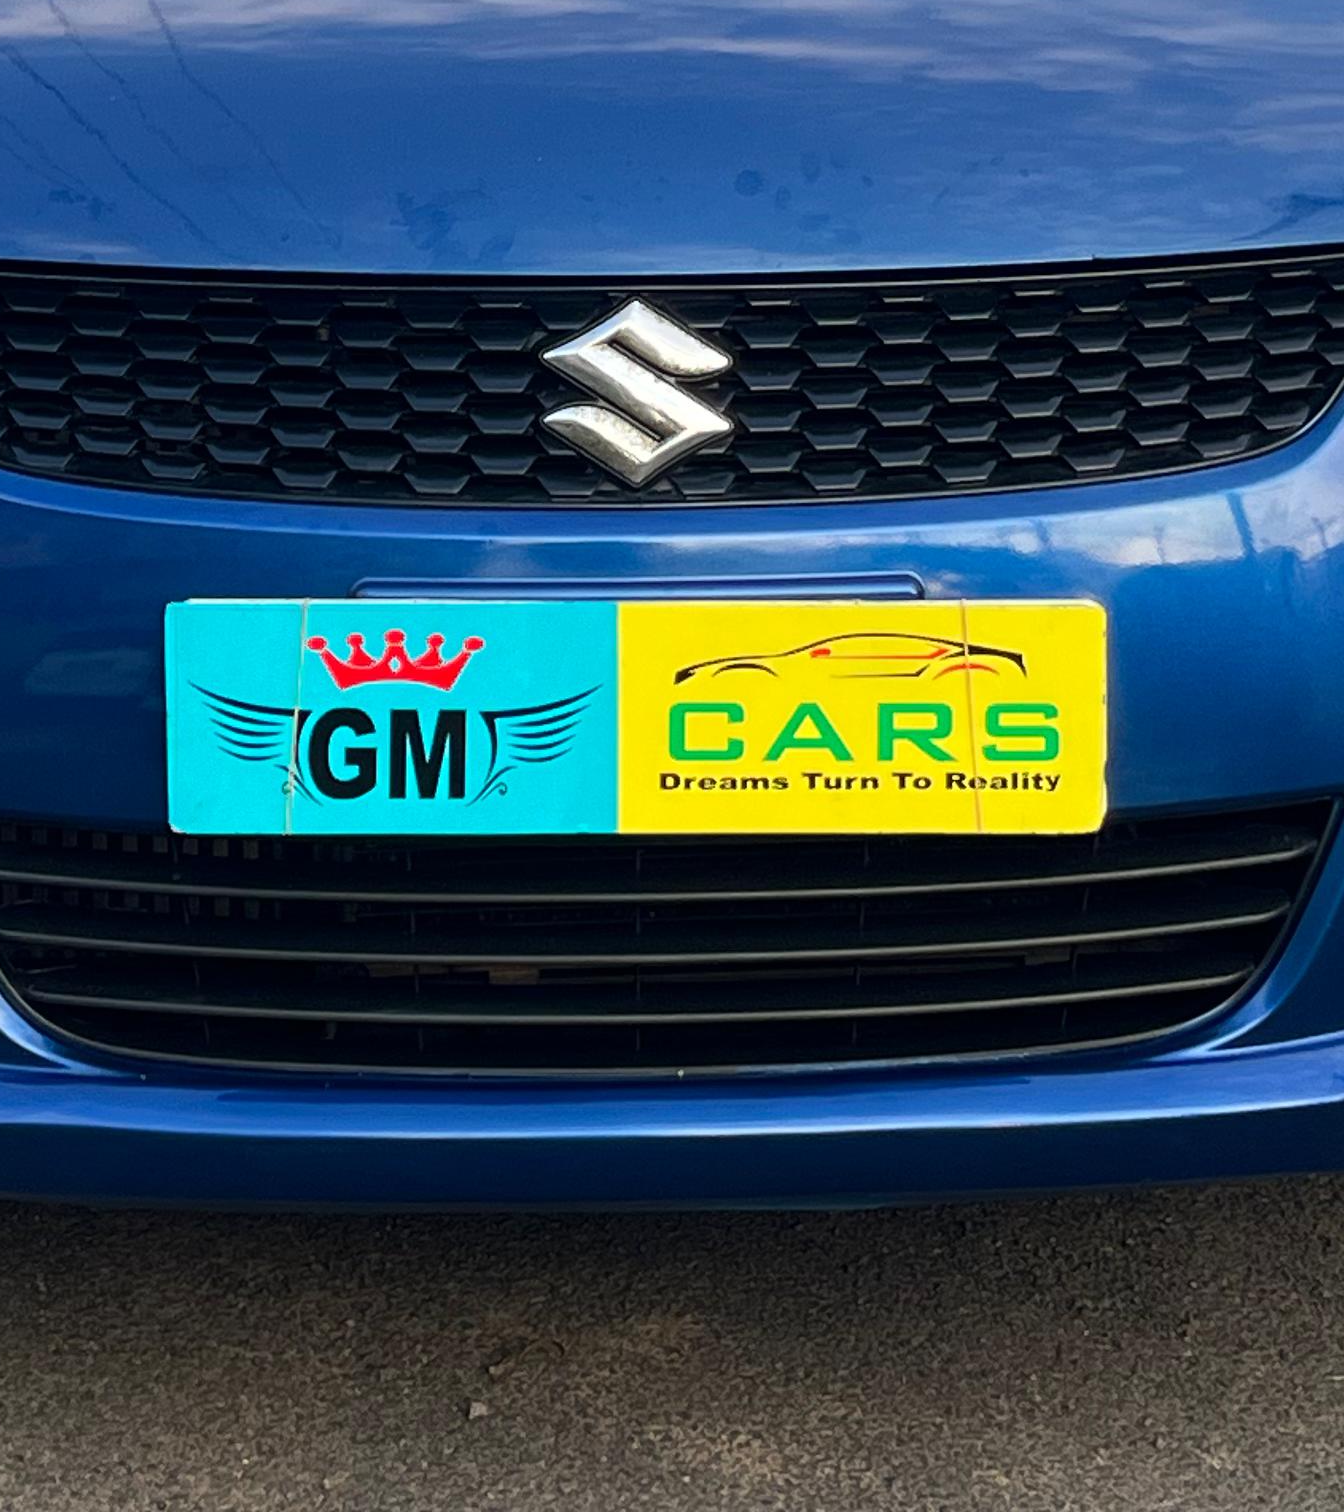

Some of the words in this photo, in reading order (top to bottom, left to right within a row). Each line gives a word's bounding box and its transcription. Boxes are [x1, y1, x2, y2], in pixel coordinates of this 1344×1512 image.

[308, 707, 467, 800] GM
[668, 702, 1059, 762] CARS
[659, 772, 789, 791] Dreams
[802, 772, 879, 791] Turn
[892, 772, 932, 791] To
[945, 772, 1061, 792] Reality
